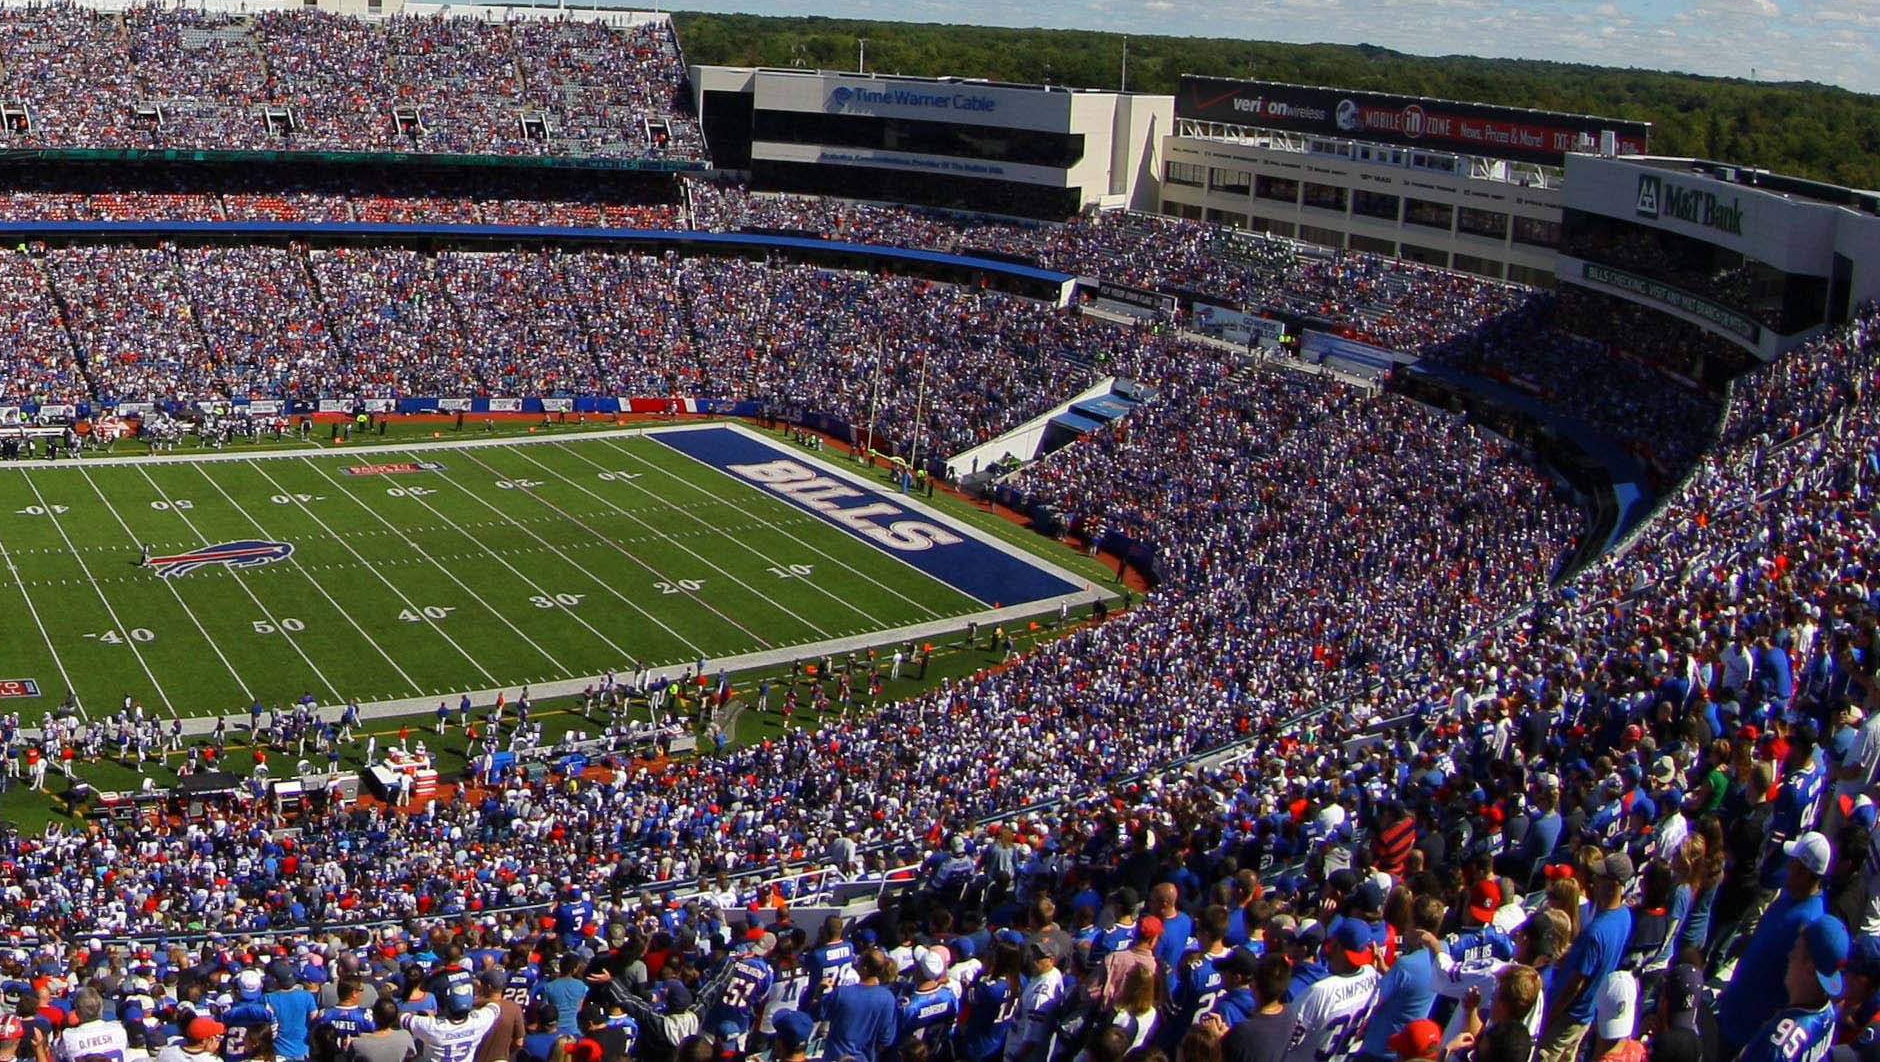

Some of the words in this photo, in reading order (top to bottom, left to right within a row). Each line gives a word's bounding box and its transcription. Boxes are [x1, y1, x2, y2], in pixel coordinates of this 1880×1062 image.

[854, 87, 892, 105] Time
[894, 90, 951, 108] Warner
[953, 94, 996, 112] Cable
[1366, 111, 1401, 130] MOBILE
[1425, 117, 1452, 137] ZONE
[1663, 184, 1704, 223] M&T
[1704, 193, 1743, 235] Bank
[1589, 267, 1609, 283] BILLS
[727, 458, 963, 552] BILLS
[766, 564, 808, 579] 10
[653, 579, 699, 595] 20
[530, 593, 577, 609] 30
[398, 606, 447, 622] 40
[253, 618, 305, 634] 50
[98, 628, 155, 645] 40
[573, 915, 583, 931] 3
[504, 987, 529, 1006] 22
[723, 976, 757, 1007] 51
[1336, 975, 1378, 1003] SIMPSON
[1771, 1018, 1807, 1059] 95
